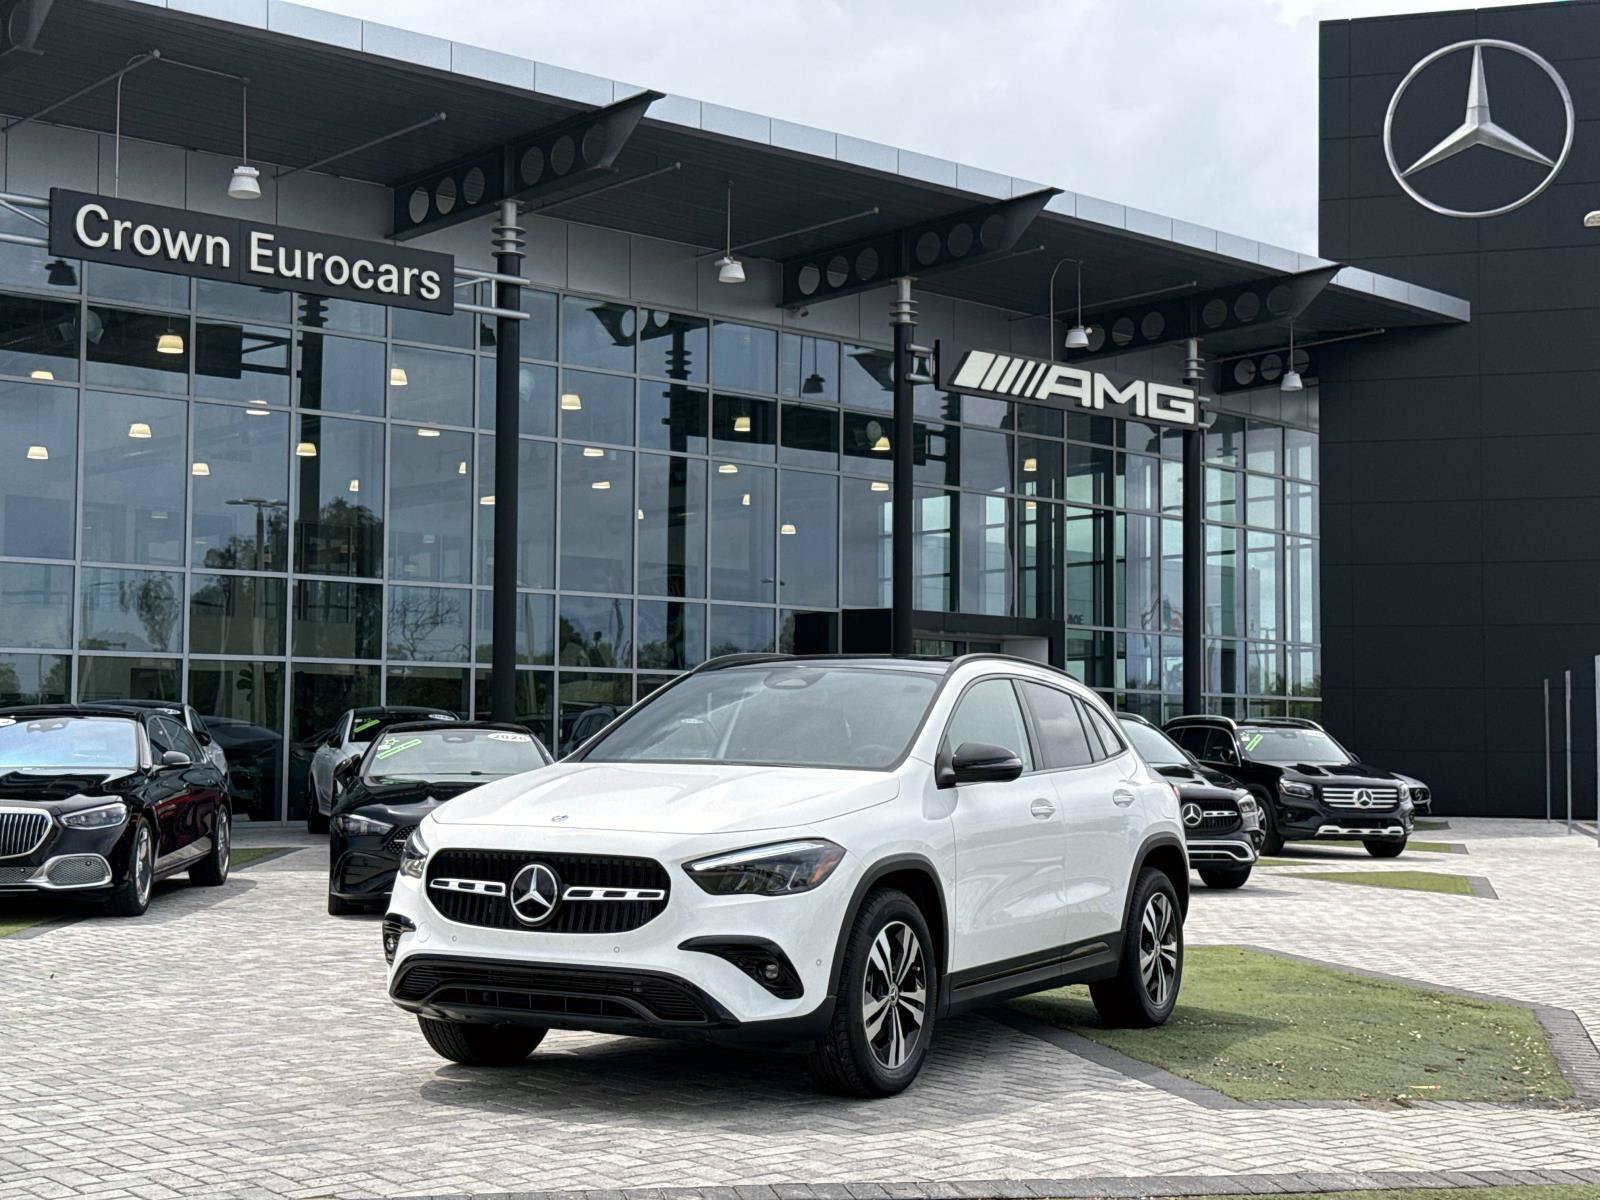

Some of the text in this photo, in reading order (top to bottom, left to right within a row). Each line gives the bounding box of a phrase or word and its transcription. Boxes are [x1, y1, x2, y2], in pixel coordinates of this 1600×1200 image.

[75, 203, 441, 300] Crown Eurocars
[1036, 364, 1195, 425] AMG
